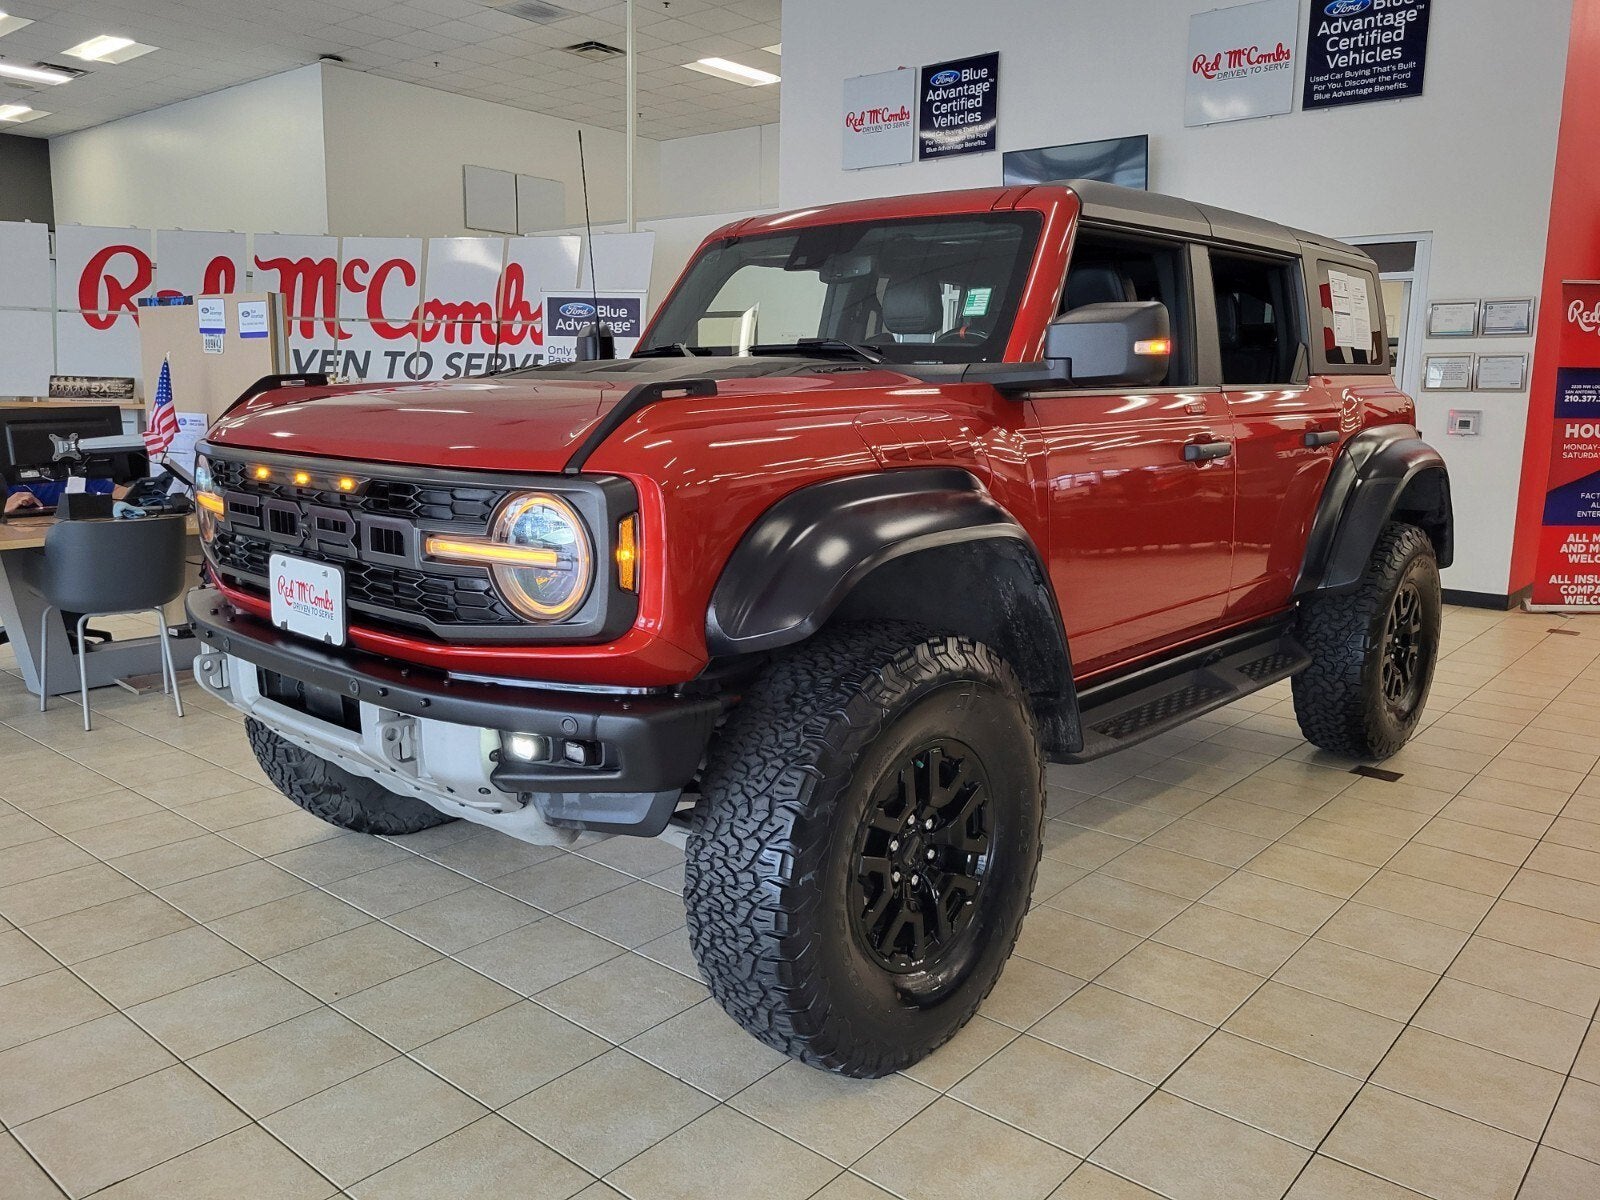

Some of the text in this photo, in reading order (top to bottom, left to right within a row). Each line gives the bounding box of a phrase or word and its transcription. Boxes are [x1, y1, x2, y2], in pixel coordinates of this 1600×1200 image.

[1332, 1, 1361, 14] Ford
[1326, 26, 1405, 51] Certified
[1192, 42, 1291, 80] Red McCombs
[1326, 46, 1402, 69] Vehicles
[961, 68, 988, 82] Blue
[1216, 61, 1290, 80] DRIVEN TO SERVE
[1309, 61, 1416, 83] Used Car Buying That's Built
[1313, 71, 1411, 91] For You. Discover the Ford
[1313, 82, 1408, 100] Blue Advantage Benefits.
[932, 94, 983, 115] Certified
[845, 105, 911, 133] Red McCombs
[862, 120, 911, 134] DRIVEN TO SERVE
[932, 111, 982, 128] Vehicles
[925, 140, 987, 154] Blue Advantage Benefits.
[597, 305, 628, 318] Blue
[547, 345, 572, 356] Only
[384, 351, 433, 380] TO
[1567, 533, 1589, 543] ALL
[1559, 543, 1586, 553] AND
[1549, 574, 1571, 584] ALL
[277, 575, 334, 612] Red McCombs
[293, 601, 334, 621] DRIVEN TO SERVE
